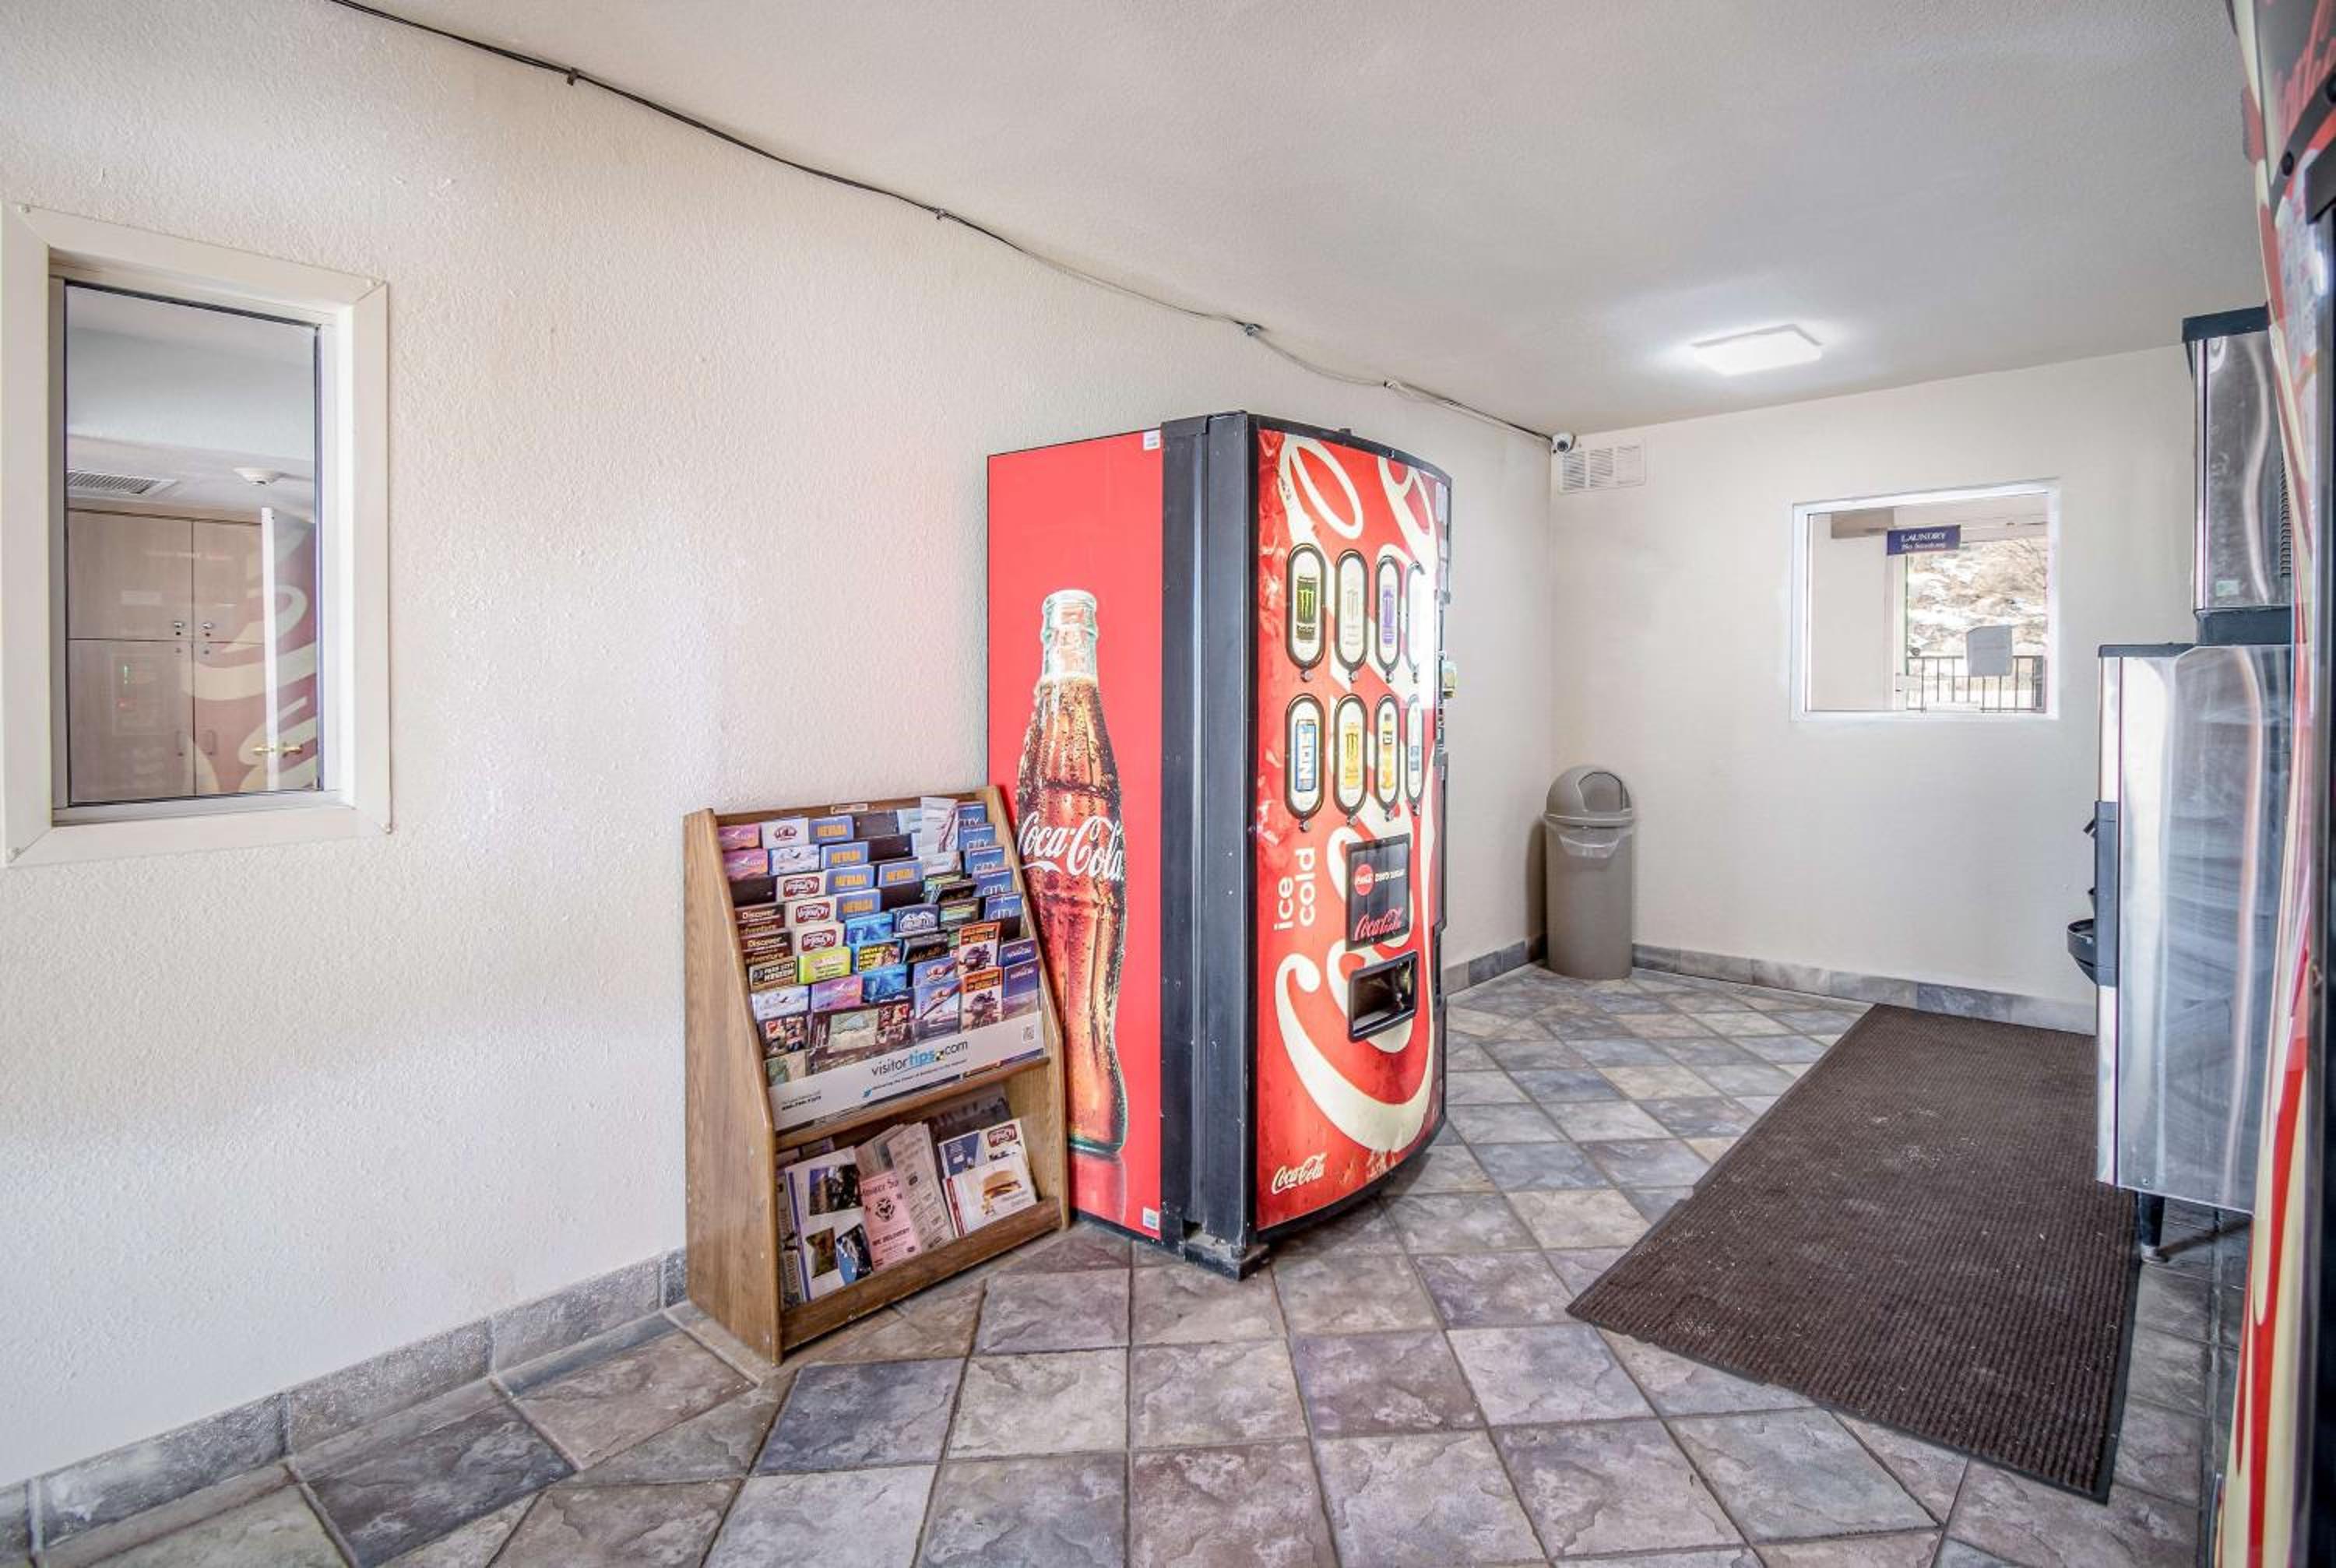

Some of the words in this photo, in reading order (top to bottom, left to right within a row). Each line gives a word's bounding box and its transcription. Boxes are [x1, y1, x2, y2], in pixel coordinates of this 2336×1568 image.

[1901, 532, 1945, 542] LAUNDRY
[1017, 810, 1124, 881] Coca-Cola
[982, 884, 1006, 895] CITY
[1273, 876, 1294, 930] ice
[1295, 847, 1316, 927] cold
[1353, 907, 1404, 940] Coca-Cola
[1272, 1153, 1328, 1194] Coca-Cola
